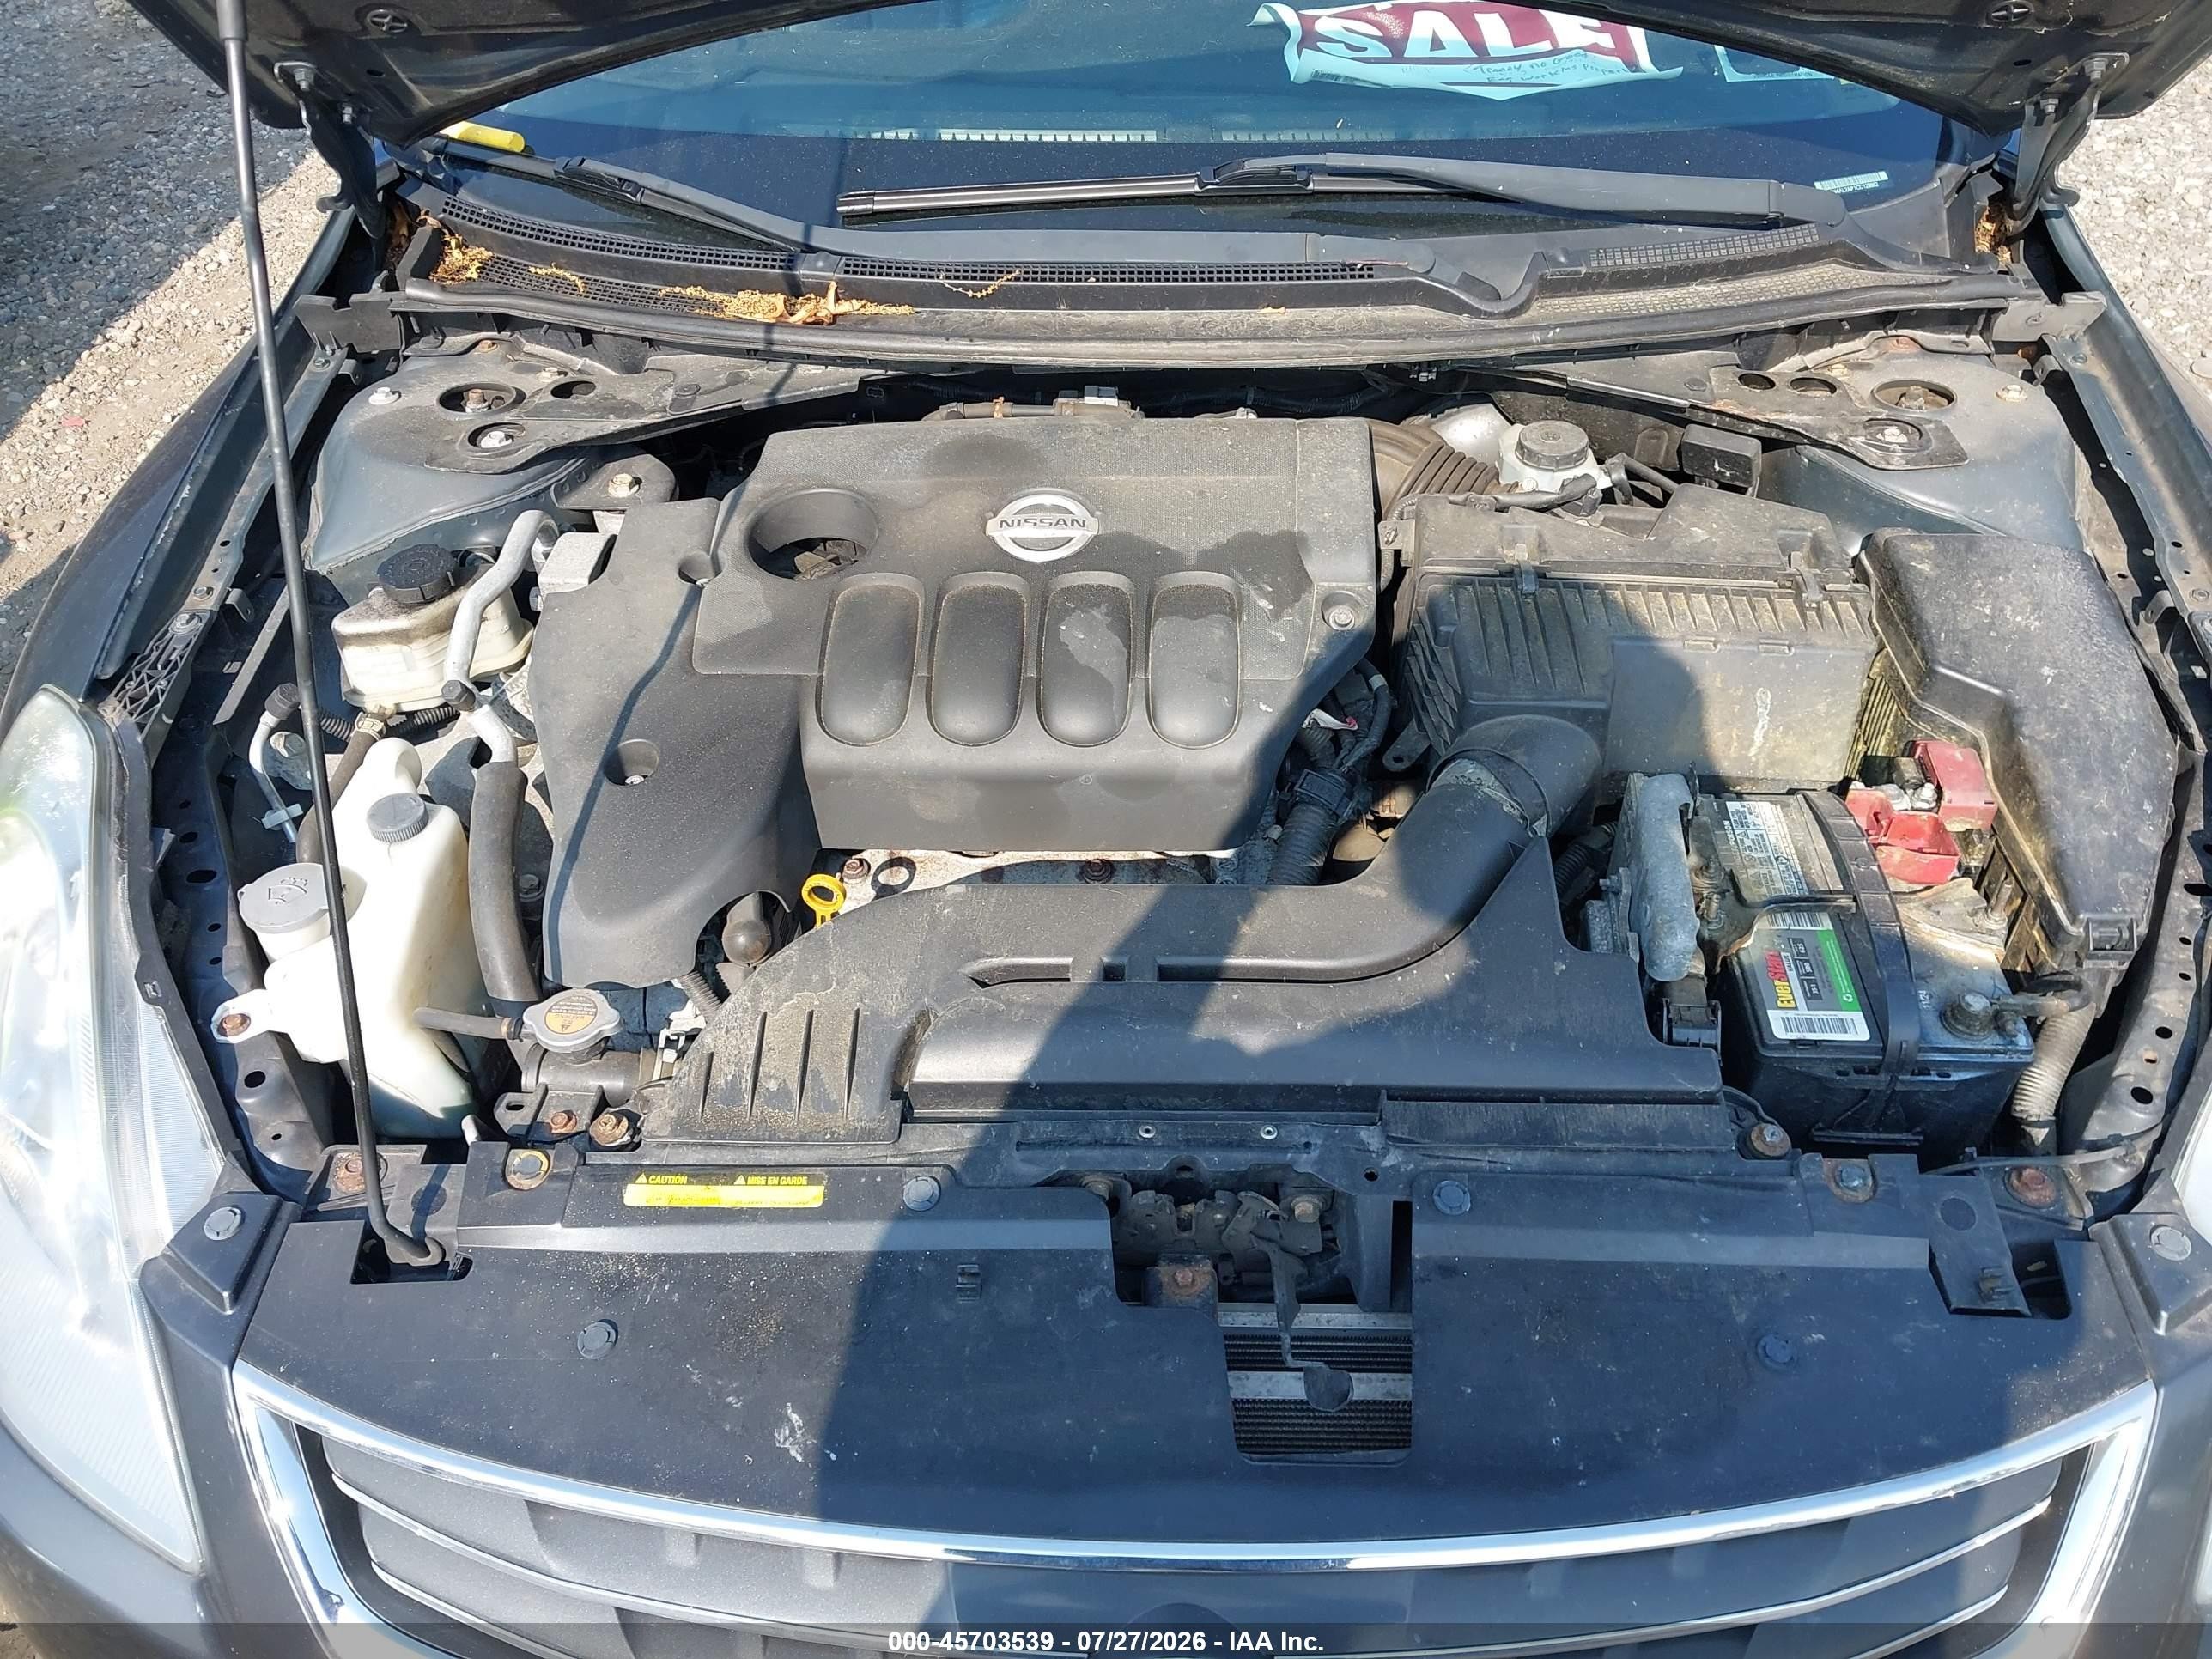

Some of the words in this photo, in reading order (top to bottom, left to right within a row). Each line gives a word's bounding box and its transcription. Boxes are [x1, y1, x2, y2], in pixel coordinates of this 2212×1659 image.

[1315, 9, 1615, 58] SALE
[999, 517, 1087, 529] NISSAN
[647, 1174, 687, 1185] CAUTION
[747, 1175, 767, 1186] MISE
[768, 1176, 780, 1186] EN
[780, 1175, 808, 1186] GARDE
